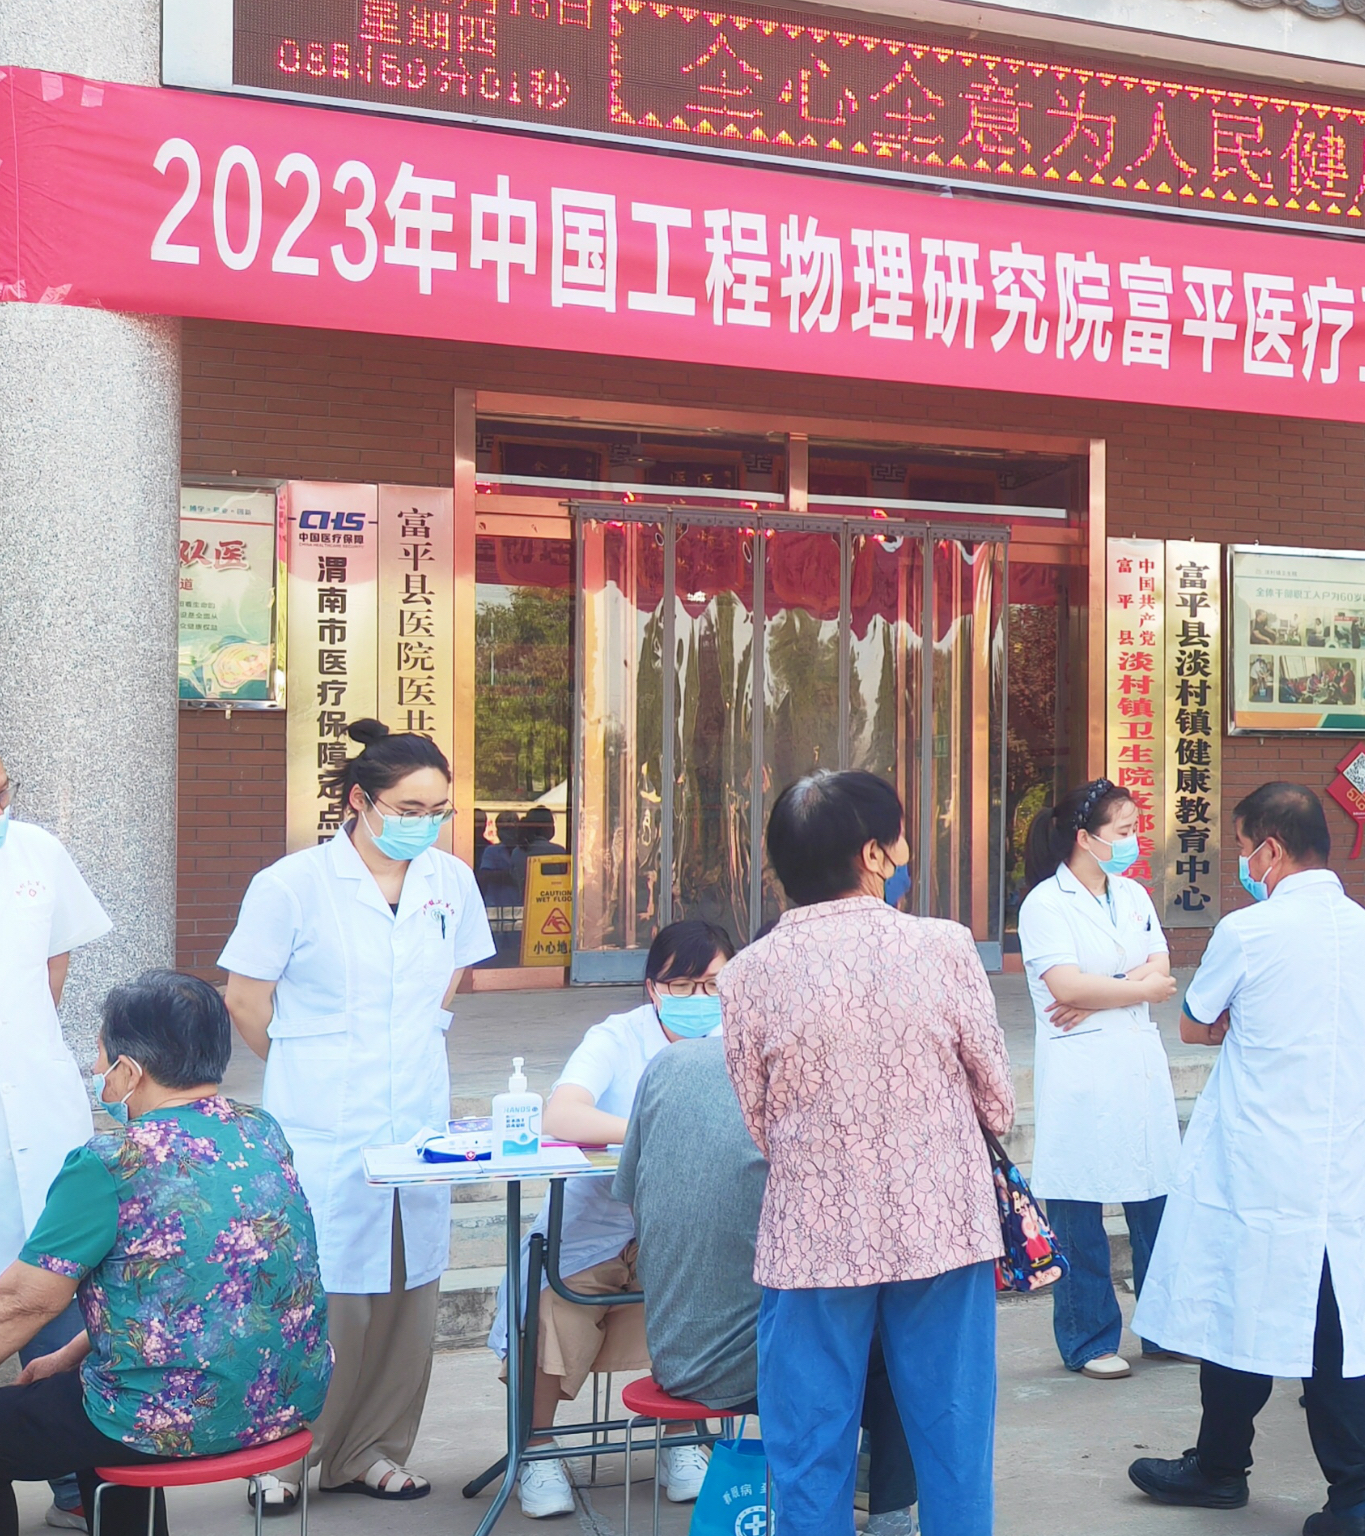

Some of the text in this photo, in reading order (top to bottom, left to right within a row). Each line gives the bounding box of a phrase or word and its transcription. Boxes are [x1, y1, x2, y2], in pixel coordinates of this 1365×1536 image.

[360, 0, 497, 57] 星期四
[299, 532, 364, 545] 中国医疗保障
[1116, 557, 1134, 646] 富平县
[1138, 557, 1157, 647] 中国共产党
[317, 555, 349, 852] 渭南市医疗保障定点
[1174, 560, 1213, 913] 富平县淡村镇健康教育中心
[1117, 650, 1156, 897] 淡村镇卫生院支部委员
[533, 940, 572, 955] 小心地
